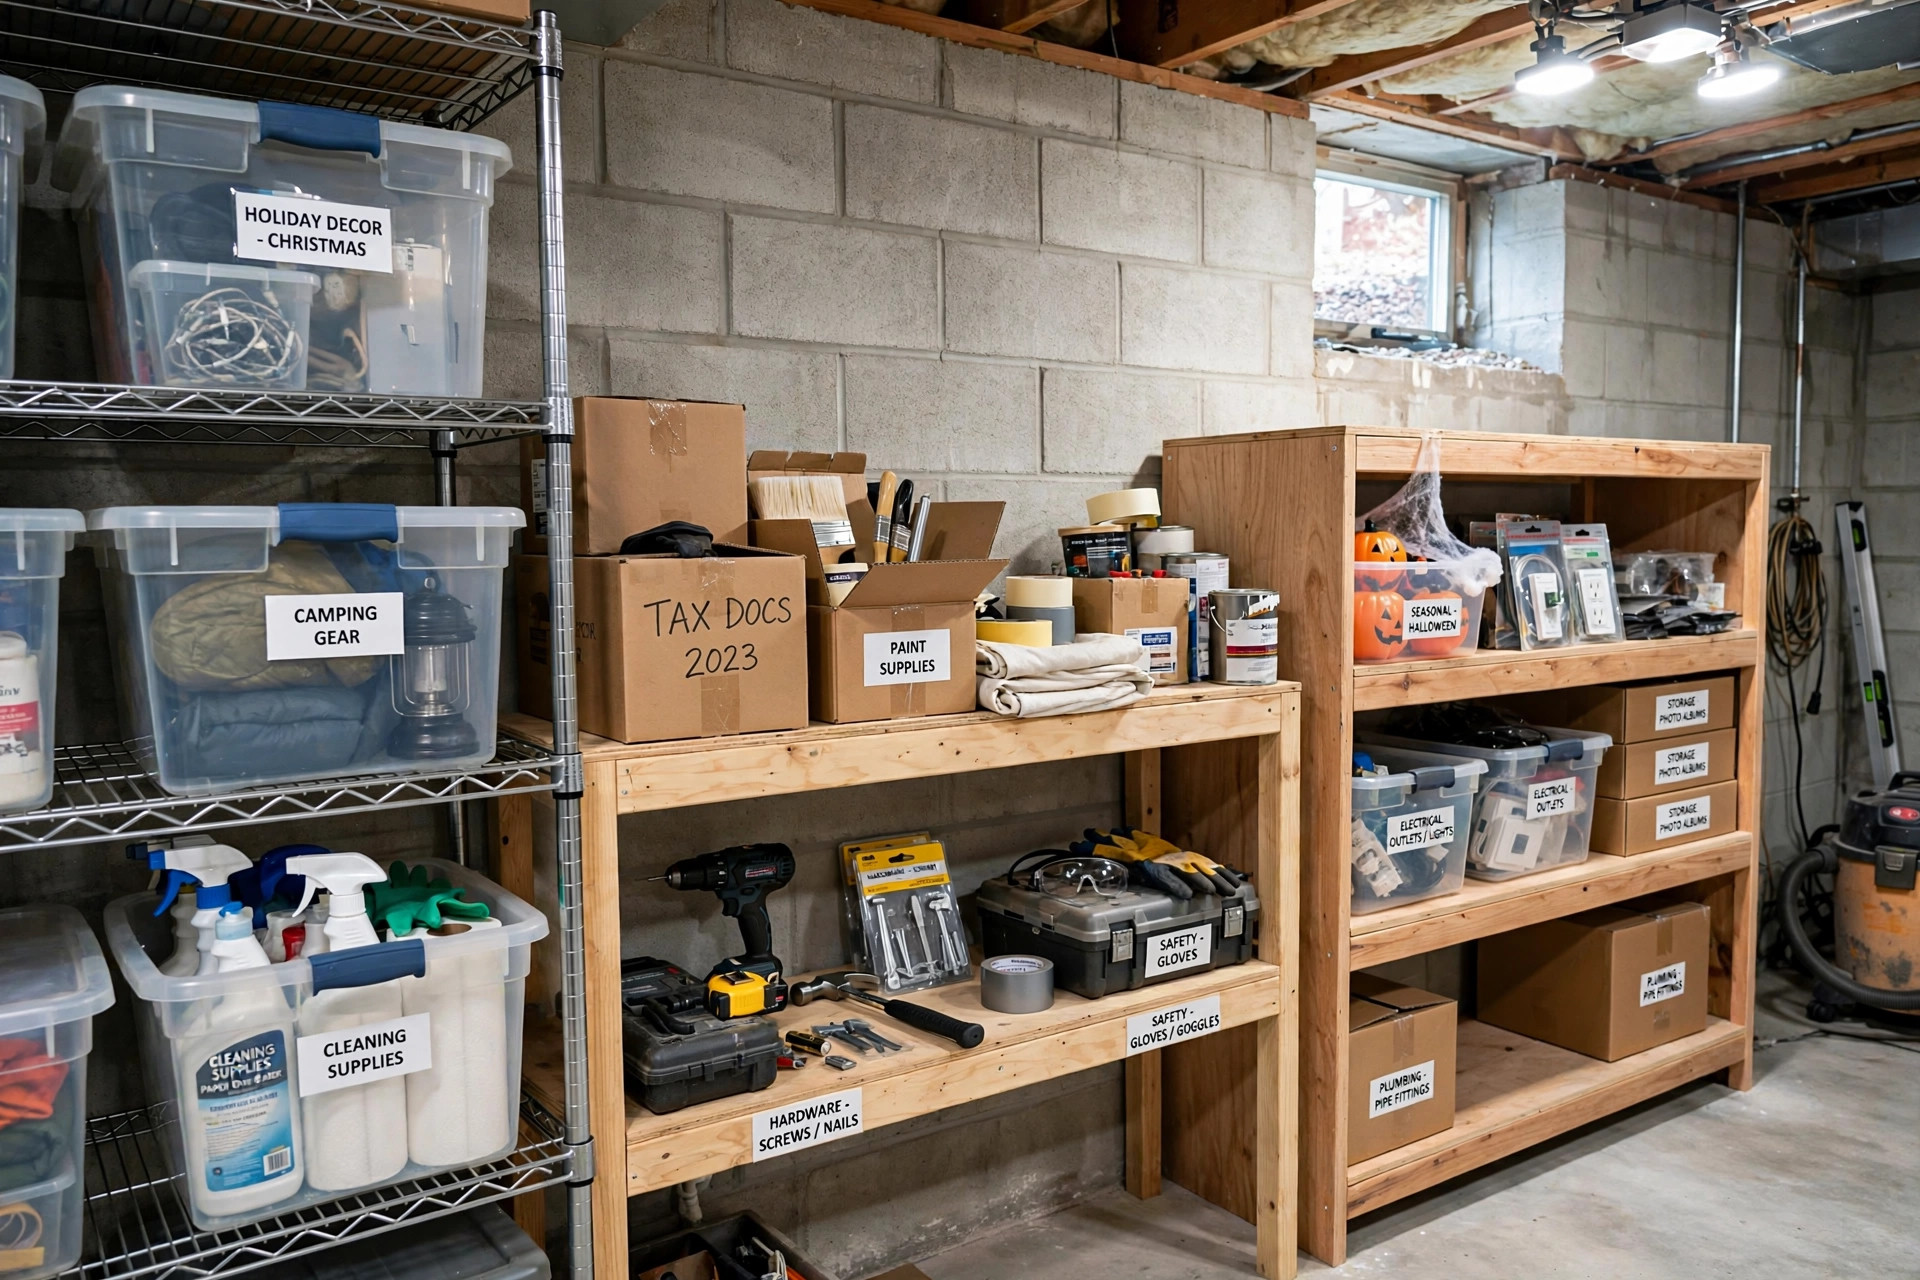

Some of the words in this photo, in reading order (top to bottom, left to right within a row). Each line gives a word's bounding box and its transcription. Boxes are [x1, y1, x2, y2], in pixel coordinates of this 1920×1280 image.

[245, 206, 321, 229] HOLIDAY
[327, 215, 382, 235] DECOR
[268, 233, 366, 256] CHRISTMAS
[294, 606, 377, 623] CAMPING
[644, 598, 710, 637] TAX
[726, 597, 791, 629] DOCS
[1411, 605, 1452, 617] SEASONAL
[1409, 619, 1456, 632] HALLOWEEN
[314, 629, 360, 646] GEAR
[891, 640, 926, 654] PAINT
[686, 643, 758, 678] 2023
[880, 659, 935, 675] SUPPLIES
[1400, 815, 1444, 831] ELECTRICAL
[1390, 832, 1422, 847] OUTLETS
[1160, 933, 1197, 951] SAFETY
[1157, 948, 1197, 967] GLOVES
[1152, 1007, 1187, 1026] SAFETY
[1130, 1029, 1167, 1048] GLOVES
[1177, 1014, 1219, 1036] GOGGLES
[323, 1029, 406, 1057] CLEANING
[209, 1044, 275, 1068] CLEANING
[328, 1051, 404, 1079] SUPPLIES
[1380, 1071, 1421, 1093] PLUMBING
[1375, 1095, 1392, 1110] PIPE
[1395, 1083, 1430, 1104] FITTINGS
[770, 1100, 842, 1130] HARDWARE
[759, 1126, 811, 1152] SCREWS
[814, 1122, 820, 1139] /
[824, 1114, 859, 1134] NAILS
